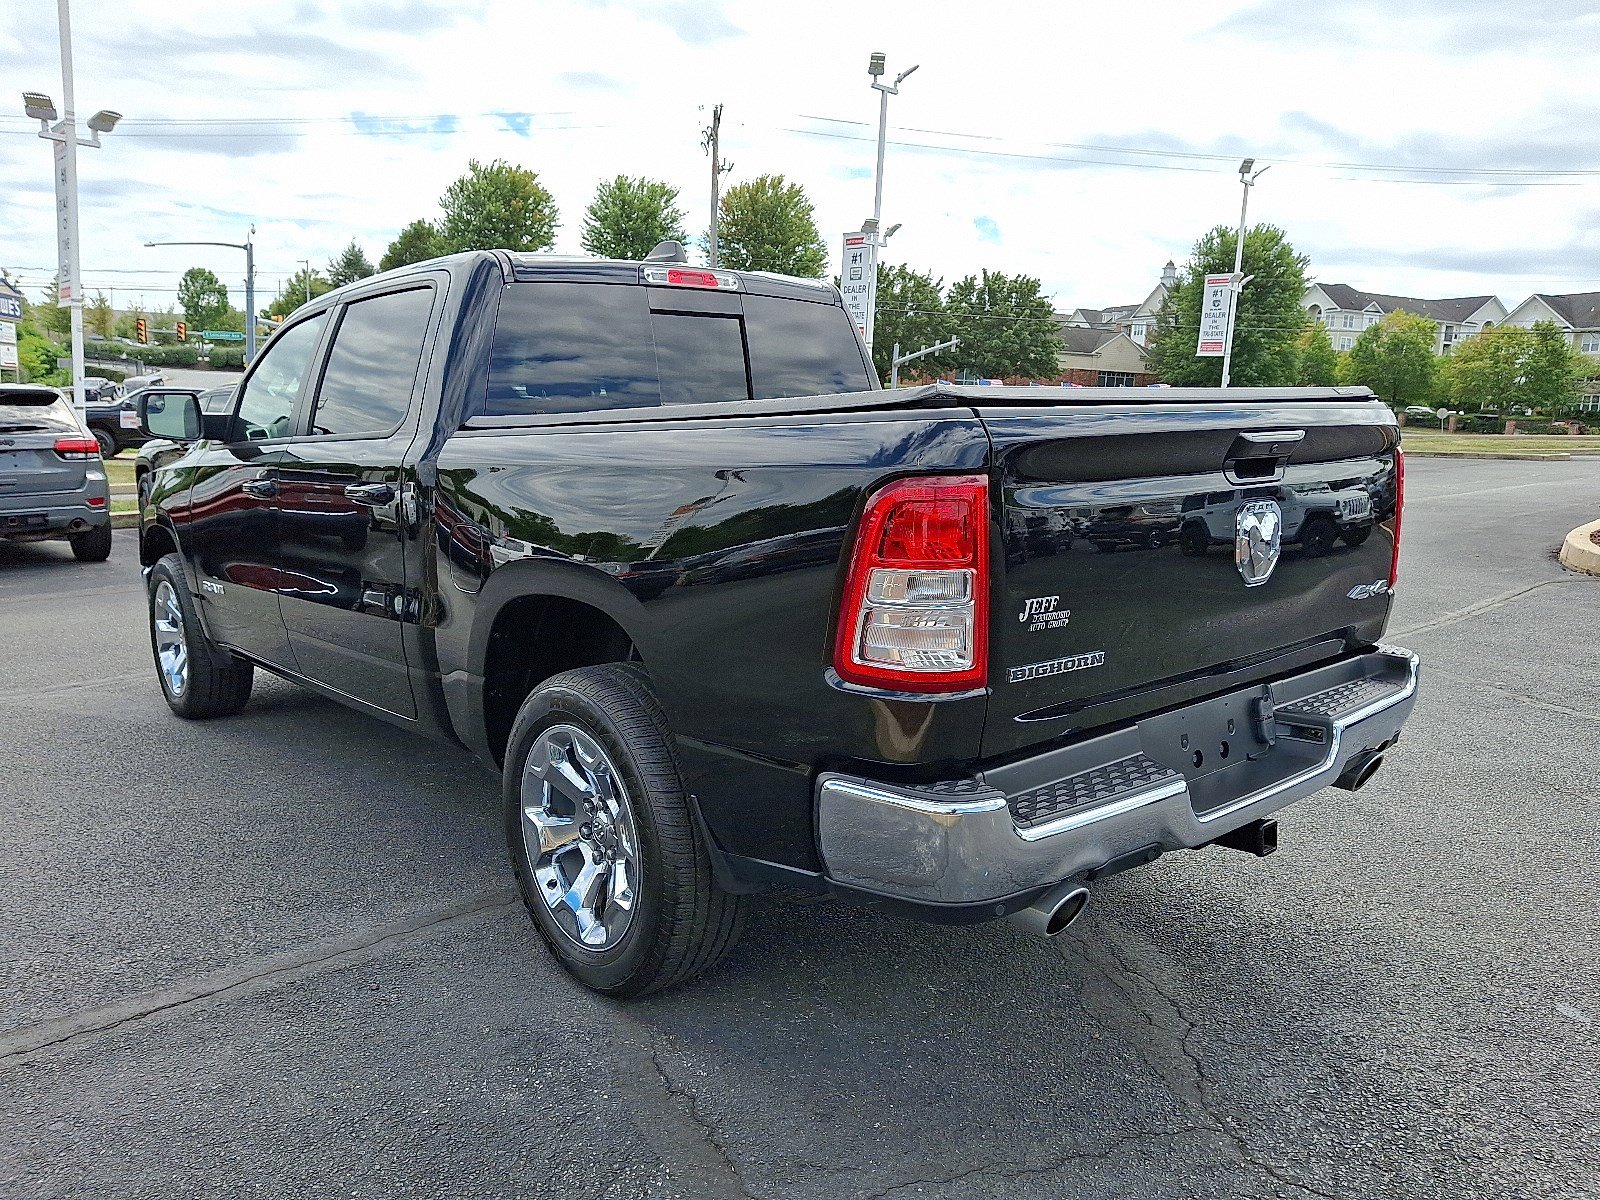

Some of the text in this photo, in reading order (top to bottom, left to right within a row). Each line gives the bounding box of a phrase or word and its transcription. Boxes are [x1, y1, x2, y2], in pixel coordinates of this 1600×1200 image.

[851, 252, 862, 264] #1
[844, 285, 866, 293] DEALER
[1212, 289, 1223, 297] #1
[1019, 595, 1060, 622] JEFF
[1027, 618, 1069, 632] AUTO GROUP
